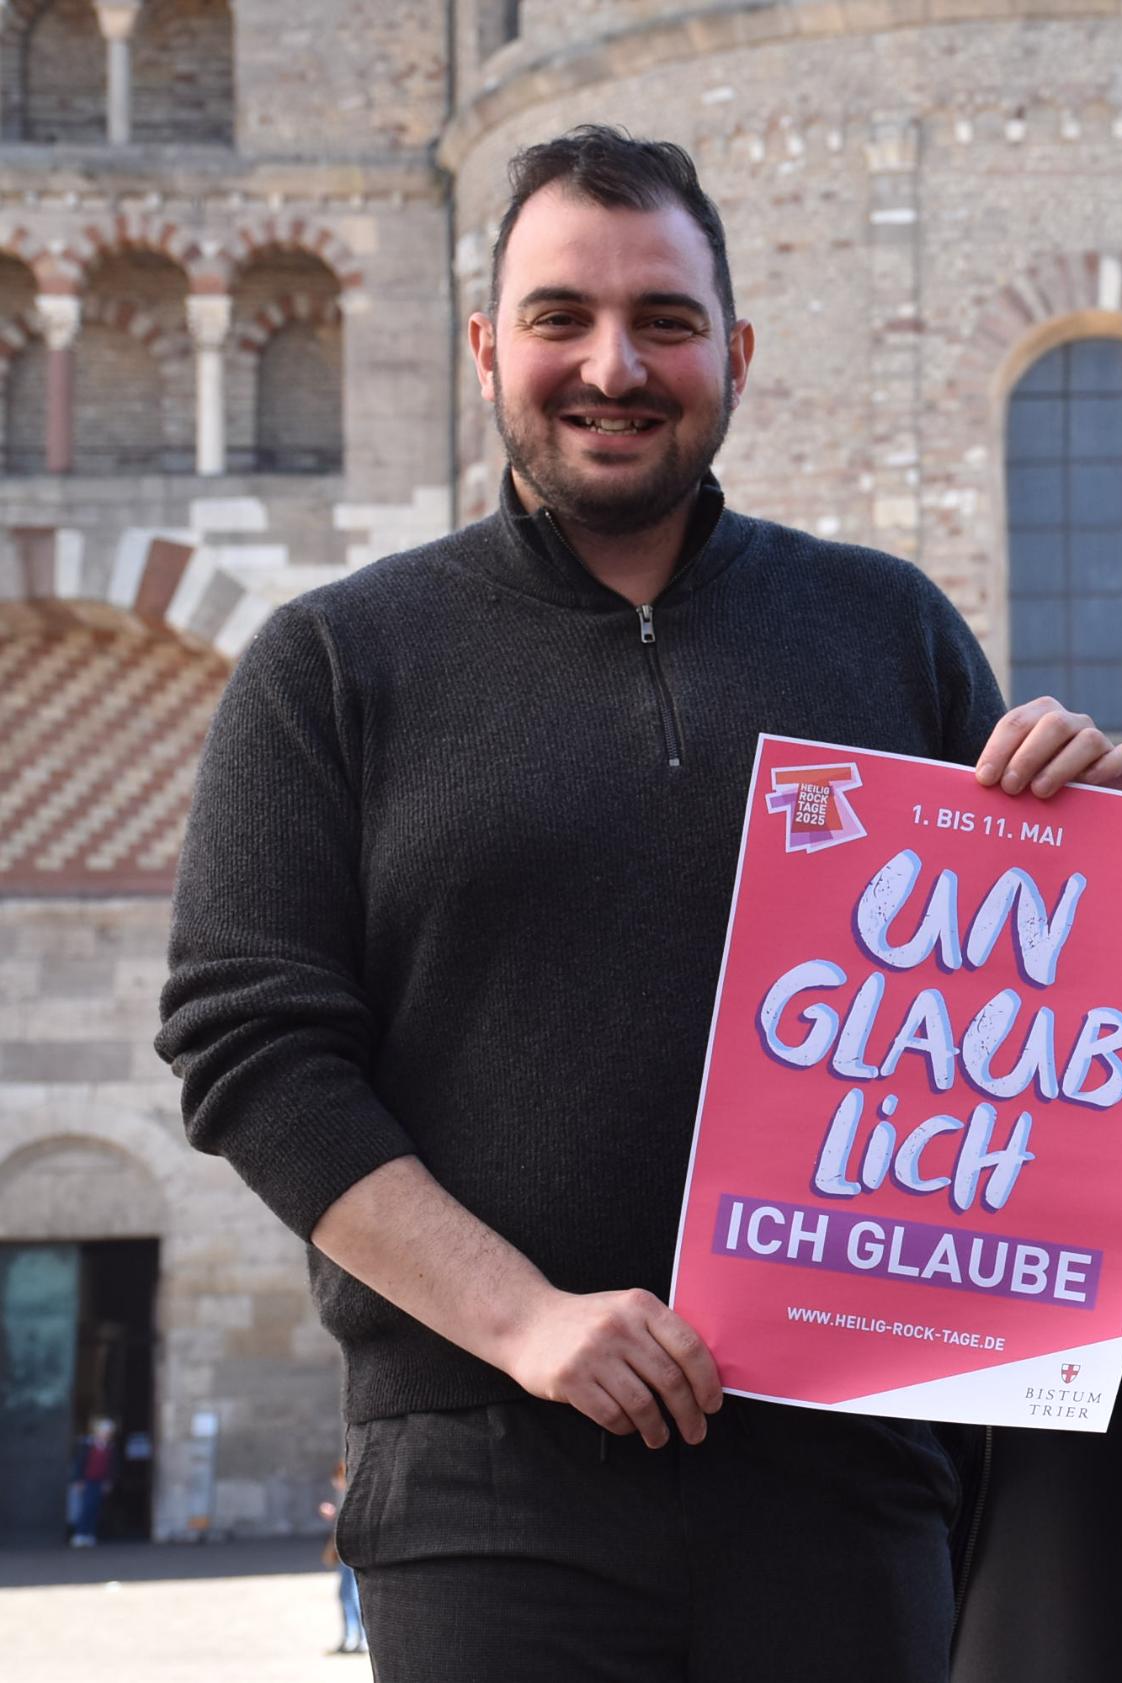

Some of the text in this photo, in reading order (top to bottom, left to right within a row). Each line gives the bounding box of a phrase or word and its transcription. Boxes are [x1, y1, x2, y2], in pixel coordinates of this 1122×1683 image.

[800, 783, 830, 794] HEILIG
[799, 791, 829, 804] ROCK
[798, 801, 827, 815] TAGE
[795, 812, 825, 826] 2025
[912, 804, 1063, 847] 1. BIS 11. MAI
[854, 848, 1088, 989] UN
[724, 1201, 1094, 1303] ICH GLAUBE
[787, 1306, 1006, 1351] WWW.HEILIG-ROCK-TAGE.DE
[1025, 1387, 1102, 1404] BISTUM
[1029, 1404, 1089, 1419] TRIER
